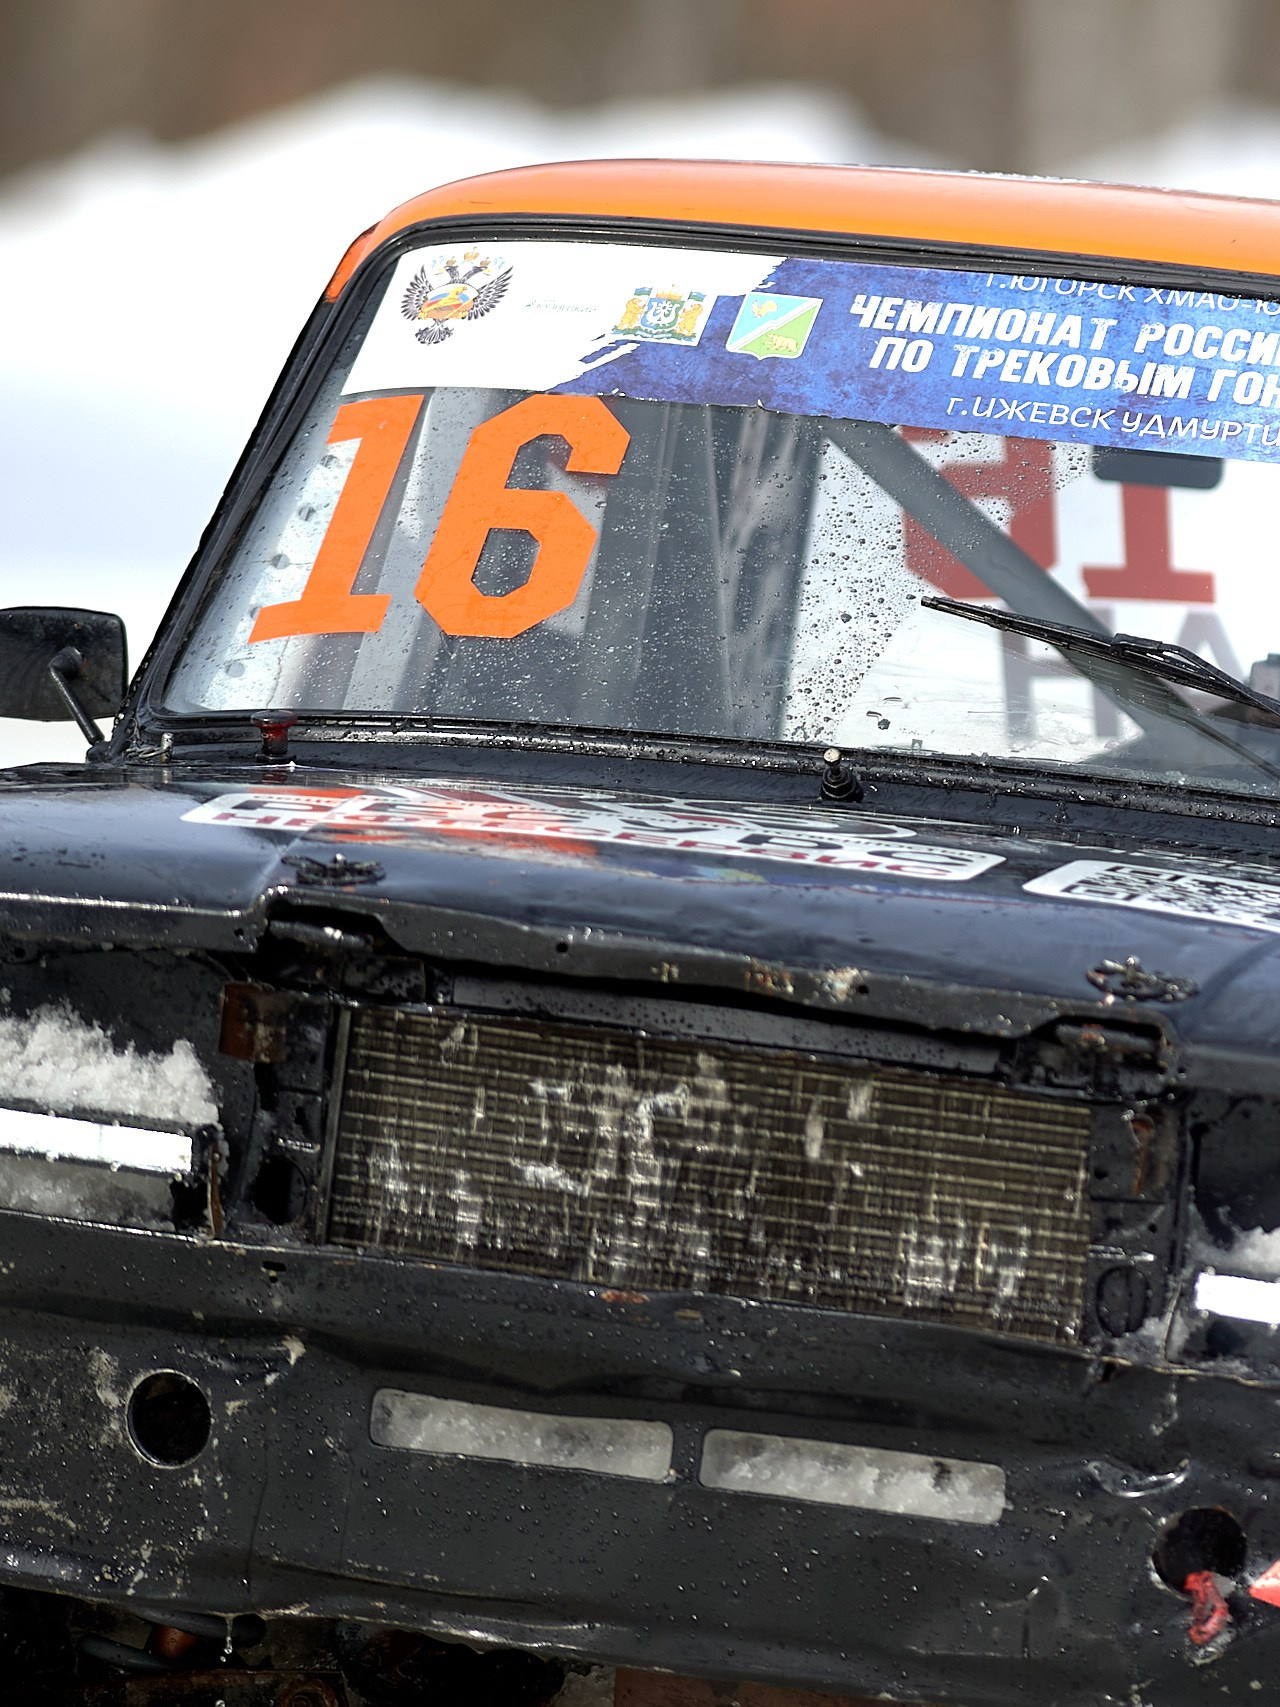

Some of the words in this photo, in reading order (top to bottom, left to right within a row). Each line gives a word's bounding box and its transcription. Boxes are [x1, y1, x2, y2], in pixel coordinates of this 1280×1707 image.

[850, 294, 1118, 350] ЧЕМПИОНАТ
[868, 336, 934, 373] ПО
[951, 344, 1195, 399] ТРЕКОВЫМ
[248, 393, 631, 645] 16
